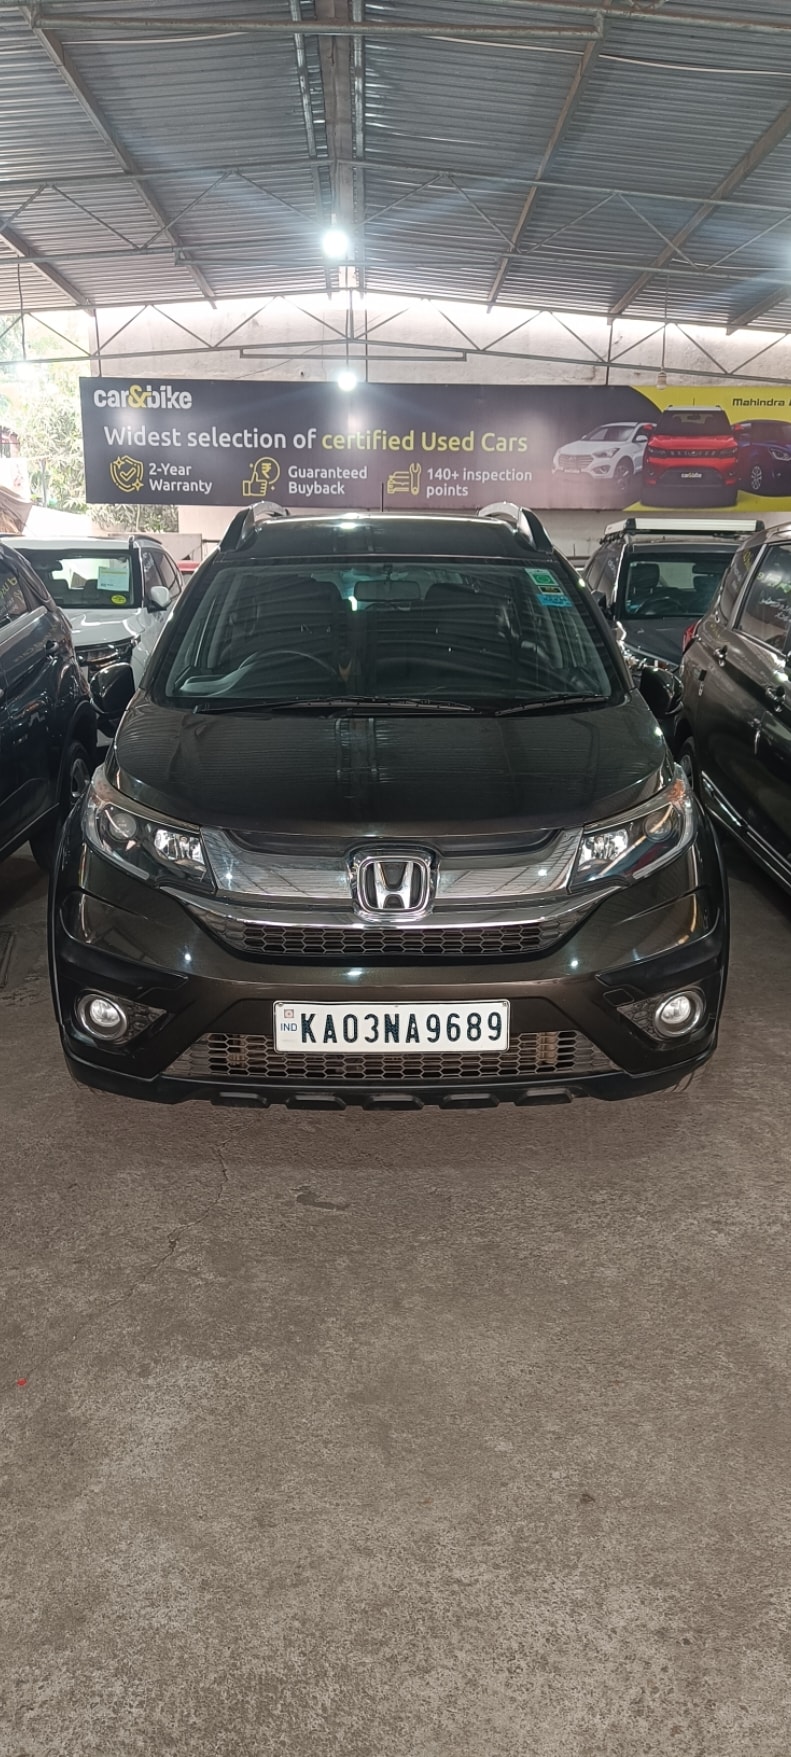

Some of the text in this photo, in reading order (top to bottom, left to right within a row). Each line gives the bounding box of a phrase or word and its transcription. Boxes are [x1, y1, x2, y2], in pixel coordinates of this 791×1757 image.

[94, 384, 192, 409] car&bike
[732, 397, 785, 406] Mahindra
[104, 426, 528, 452] Widest selection of certified Used Cars
[149, 463, 192, 476] 2-Year
[288, 466, 368, 479] Guaranteed
[427, 467, 532, 483] 140+ inspection
[149, 478, 213, 495] Warranty
[288, 481, 345, 496] Buyback
[426, 484, 469, 499] points
[280, 1023, 298, 1032] IND
[300, 1011, 502, 1044] KA03NA9689
